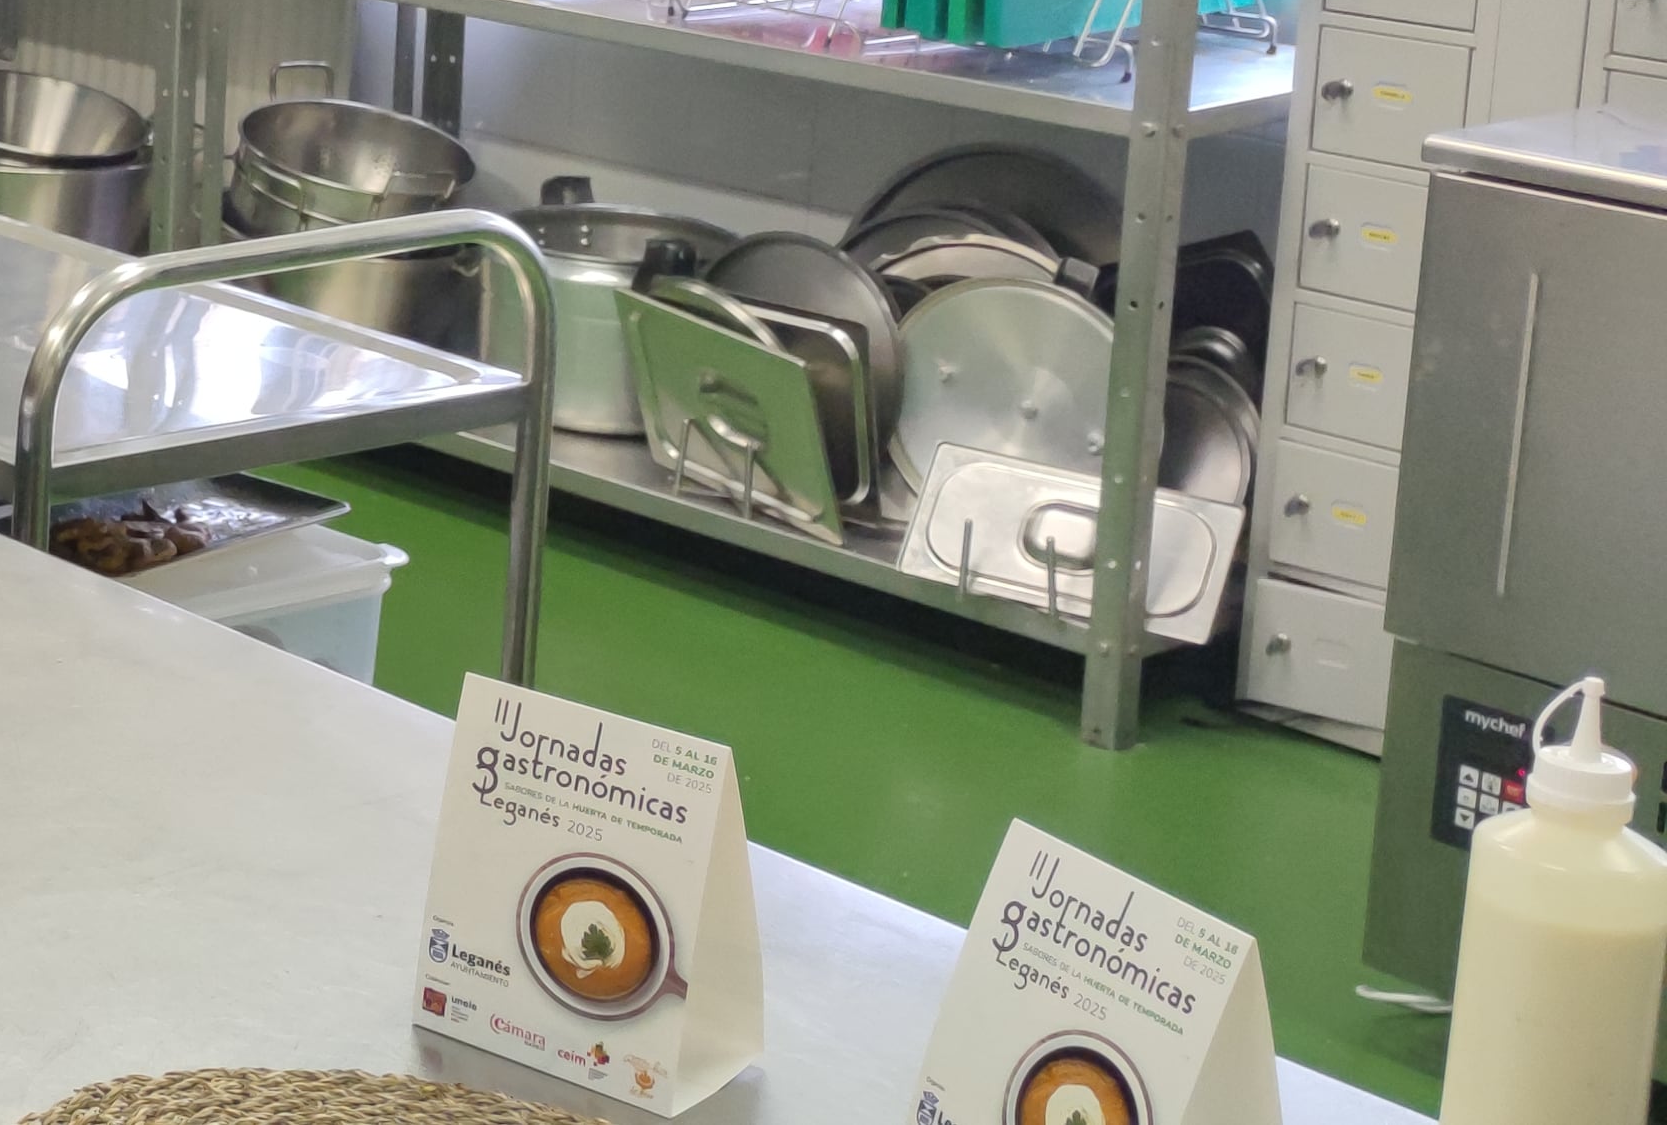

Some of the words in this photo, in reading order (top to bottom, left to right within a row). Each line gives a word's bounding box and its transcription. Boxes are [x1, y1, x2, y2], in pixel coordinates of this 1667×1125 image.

[500, 702, 627, 776] Jornadas
[1465, 710, 1526, 739] mychef
[651, 739, 672, 753] DEL
[674, 746, 682, 755] 5
[686, 749, 700, 761] AL
[704, 754, 718, 766] 16
[653, 754, 668, 766] DE
[671, 759, 715, 780] MARZO
[472, 746, 689, 824] gastronómicas
[667, 772, 683, 784] DE
[685, 777, 713, 794] 2025
[480, 776, 561, 826] Leganés
[567, 820, 604, 842] 2025
[504, 781, 543, 800] SABORES
[545, 794, 557, 804] DE
[559, 798, 570, 809] LA
[572, 803, 607, 820] HUERTA
[610, 815, 623, 825] DE
[627, 819, 683, 844] TEMPORADA
[1031, 857, 1148, 953] Jornadas
[1175, 934, 1191, 949] DE
[1191, 942, 1232, 969] MARZO
[1176, 916, 1196, 936] DEL
[1198, 928, 1207, 938] 5
[1207, 932, 1222, 949] AL
[1225, 941, 1239, 955] 16
[451, 961, 509, 987] AYUNTAMIENTO
[452, 944, 511, 976] Leganés
[992, 900, 1197, 1015] gastronómicas
[1183, 955, 1198, 971] DE
[1200, 964, 1227, 986] 2025
[995, 933, 1069, 999] Leganés
[1073, 993, 1107, 1021] 2025
[1022, 942, 1058, 967] SABORES
[1060, 961, 1071, 973] DE
[1072, 967, 1082, 979] LA
[1083, 976, 1115, 999] HUERTA
[1119, 994, 1130, 1006] DE
[1133, 1001, 1184, 1036] TEMPORADA
[494, 1017, 546, 1050] Cámara
